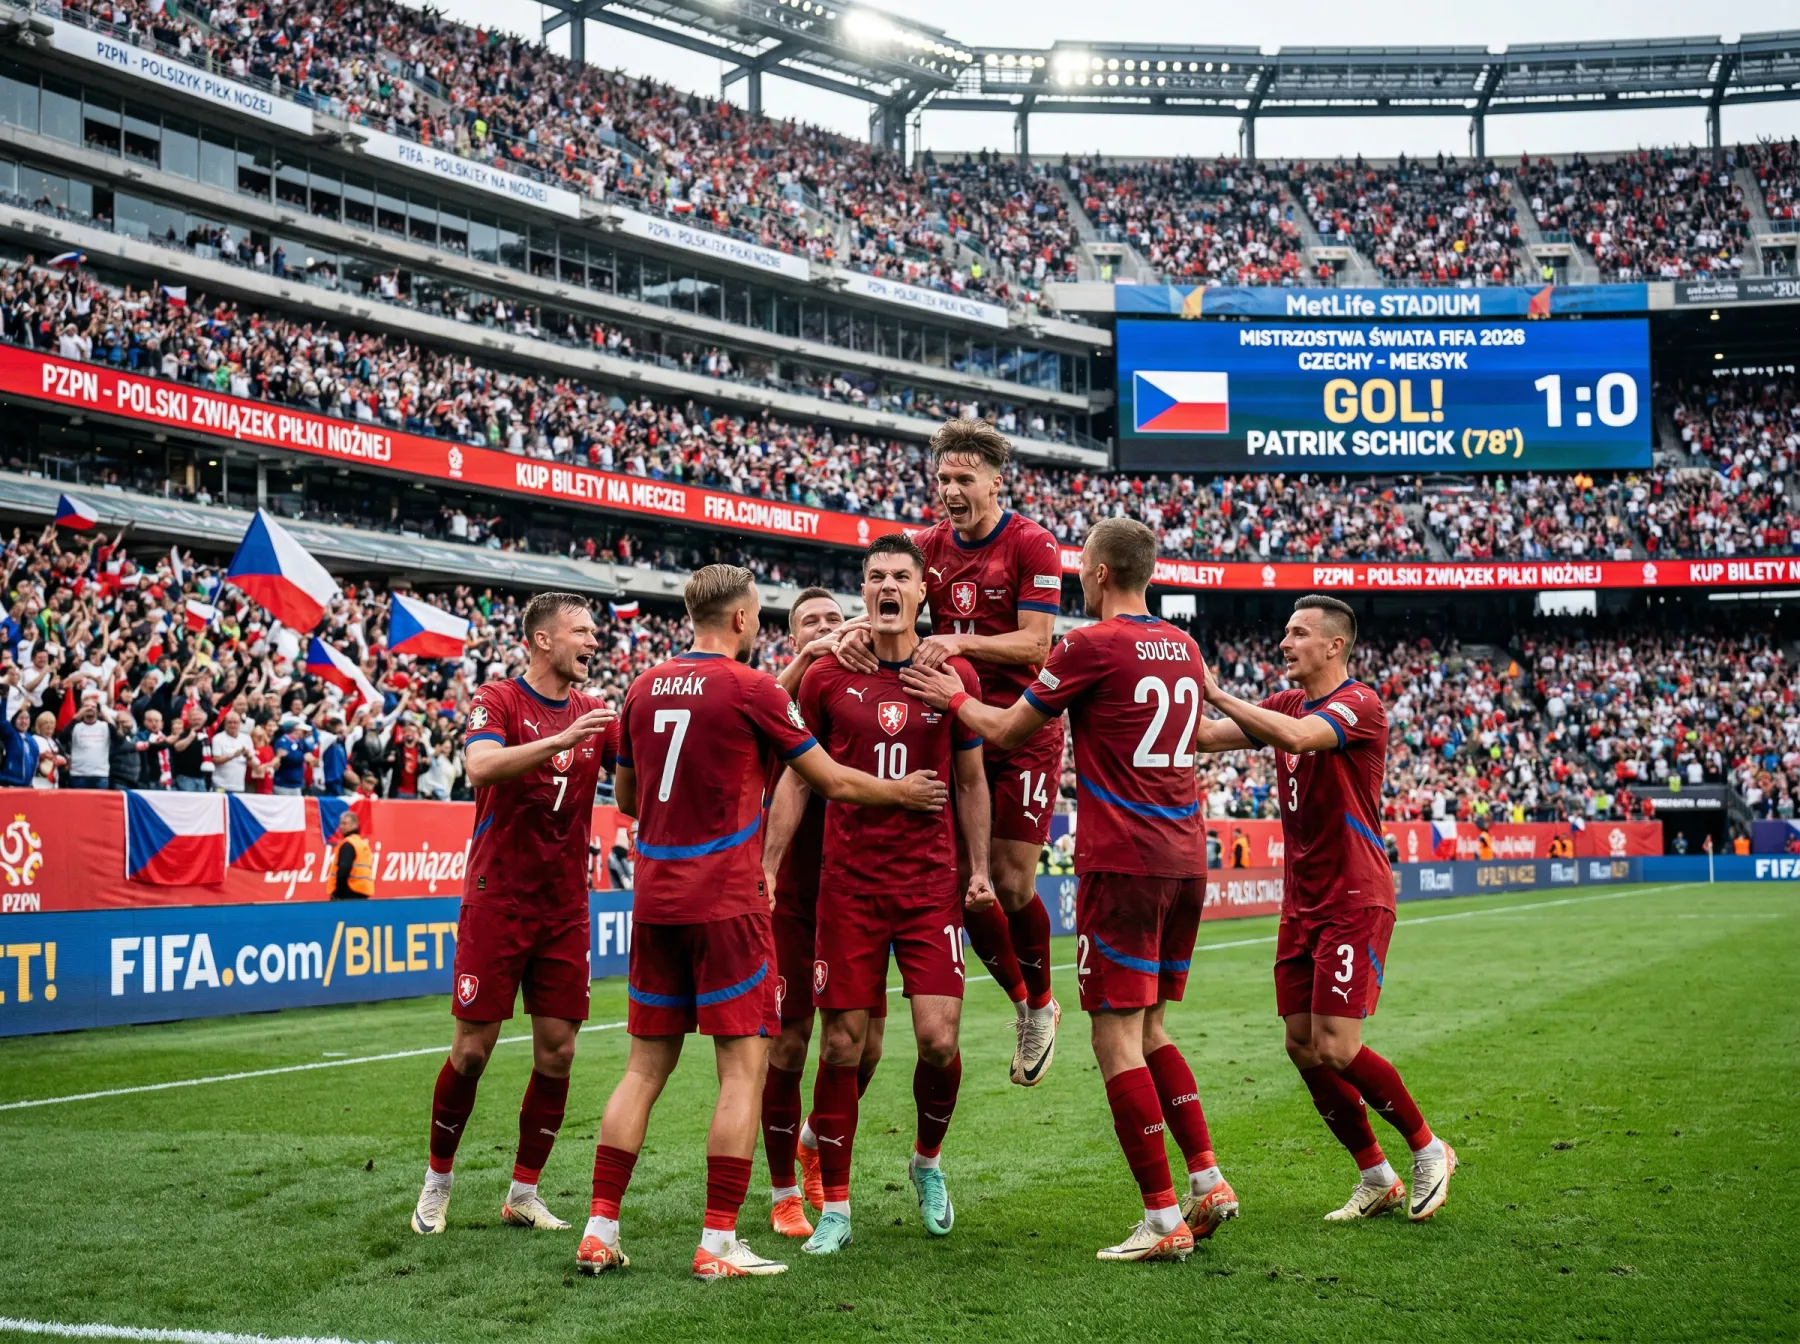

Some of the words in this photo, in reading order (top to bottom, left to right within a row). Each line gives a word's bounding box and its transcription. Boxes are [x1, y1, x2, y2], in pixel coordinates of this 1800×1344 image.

[97, 41, 128, 65] PZPN
[1286, 294, 1376, 316] MetLife
[1380, 294, 1480, 316] STADIUM
[1240, 329, 1366, 347] MISTRZOSTWA
[1369, 326, 1436, 347] ŚWIATA
[1439, 329, 1477, 346] FIFA
[1480, 328, 1526, 346] 2026
[1298, 352, 1374, 370] CZECHY
[1390, 351, 1468, 370] MEKSYK
[42, 362, 99, 403] PZPN
[117, 379, 188, 422] POLSKI
[192, 395, 275, 439] ZWIĄZEK
[278, 414, 324, 448] PIŁKI
[327, 424, 392, 462] NOŻNEJ
[1323, 378, 1445, 424] GOL!
[1534, 372, 1639, 428] 1:0
[1246, 430, 1347, 456] PATRIK
[1352, 430, 1456, 456] SCHICK
[516, 462, 549, 490] KUP
[551, 468, 604, 499] BILETY
[607, 476, 630, 504] NA
[632, 482, 686, 513] MECZE!
[703, 495, 820, 535] FIFA.COM/BILETY
[1313, 567, 1354, 585] PZPN
[1367, 566, 1422, 586] POLSKI
[1425, 565, 1494, 588] ZWIĄZEK
[1498, 565, 1538, 585] PIŁKI
[1542, 562, 1602, 584] NOŻNEJ
[1690, 563, 1724, 582] KUP
[1727, 562, 1785, 581] BILETY
[1789, 561, 1800, 580] N
[1135, 637, 1191, 661] SOUČEK
[651, 671, 707, 696] BARÁK
[1133, 676, 1199, 767] 22
[653, 709, 691, 803] 7
[873, 742, 908, 780] 10
[552, 776, 568, 812] 7
[1019, 770, 1048, 809] 14
[1287, 776, 1298, 812] 3
[2, 893, 41, 912] PZPN
[0, 942, 57, 1004] T!
[1334, 944, 1354, 983] 3
